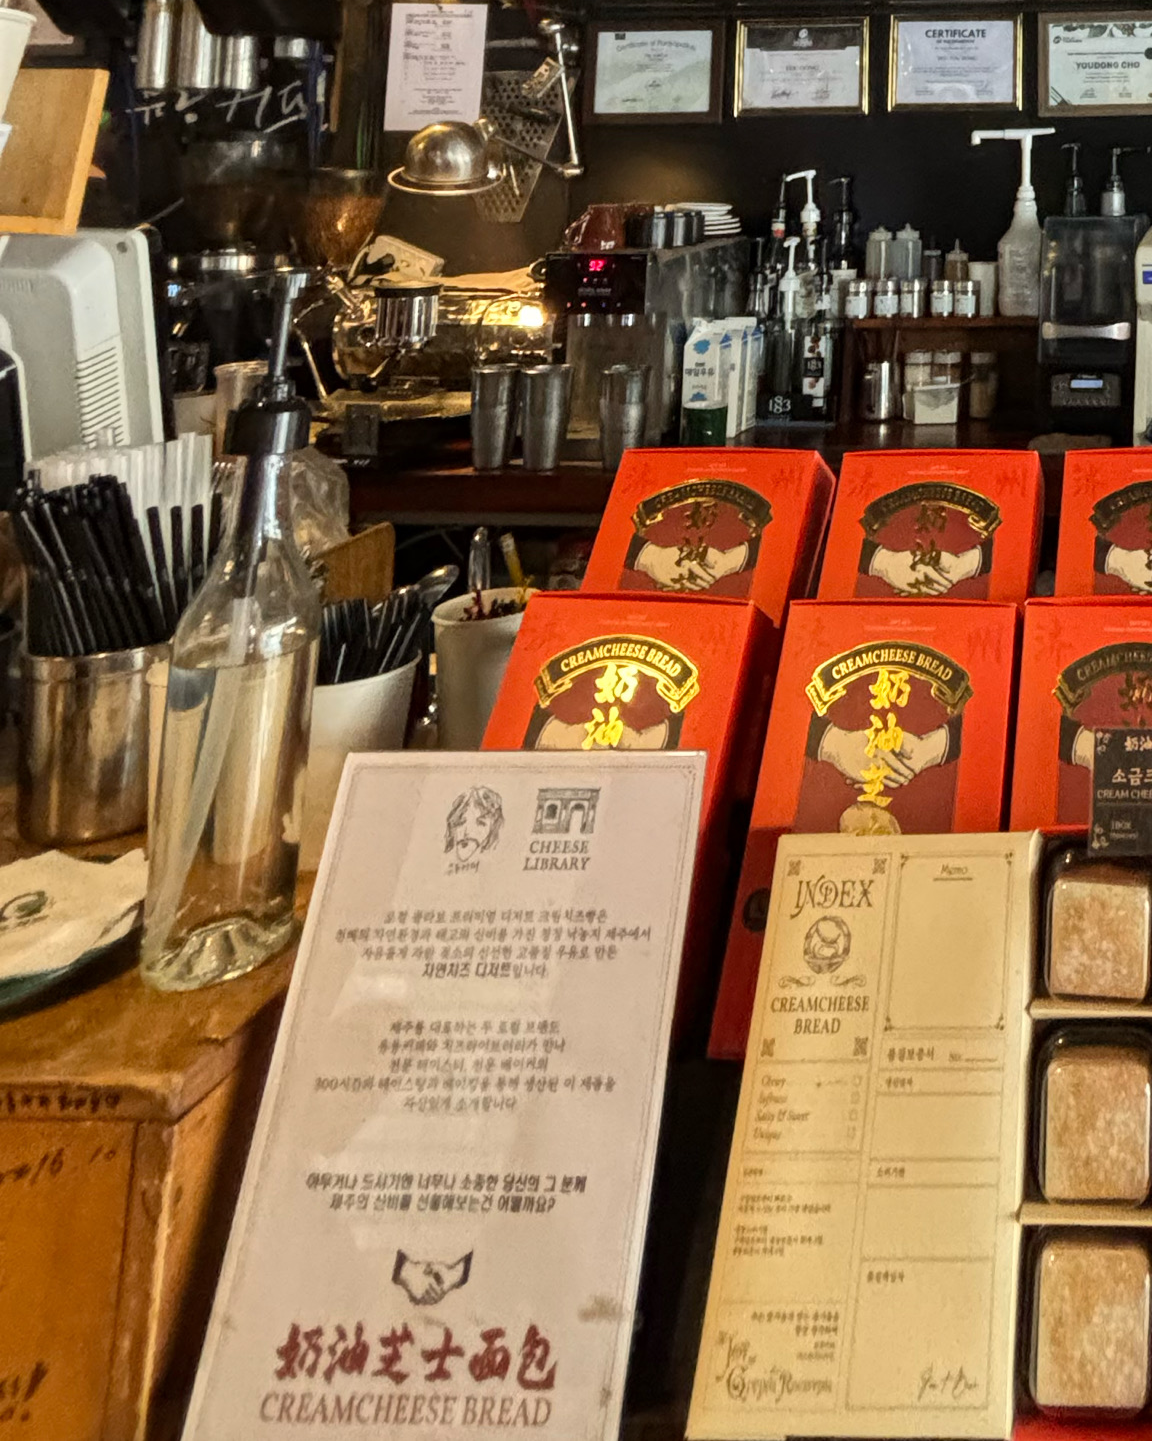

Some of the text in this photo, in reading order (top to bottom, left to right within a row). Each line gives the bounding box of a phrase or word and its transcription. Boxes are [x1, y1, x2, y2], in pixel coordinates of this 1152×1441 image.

[925, 28, 987, 39] CERTIFICATE
[1076, 61, 1141, 71] YOUDONG CHO
[768, 395, 792, 414] 183
[560, 642, 683, 678] CREAMCHEESE BREAD
[831, 648, 954, 681] CREAMCHEESE BREAD
[1096, 789, 1130, 800] CREAM
[528, 839, 590, 855] CHEESE
[522, 856, 591, 872] LIBRARY
[939, 863, 969, 876] Memo
[789, 874, 875, 920] INDEX
[421, 962, 471, 979] 자연치즈
[770, 994, 870, 1014] CREAMCHEESE
[793, 1017, 841, 1035] BREAD
[305, 1171, 358, 1190] 아무거나
[417, 1173, 457, 1191] 너무나
[502, 1173, 541, 1194] 당신의
[542, 1174, 557, 1194] 그
[274, 1321, 558, 1391] 奶油芝士面包
[258, 1390, 555, 1428] CREAMCHEESE BREAD
